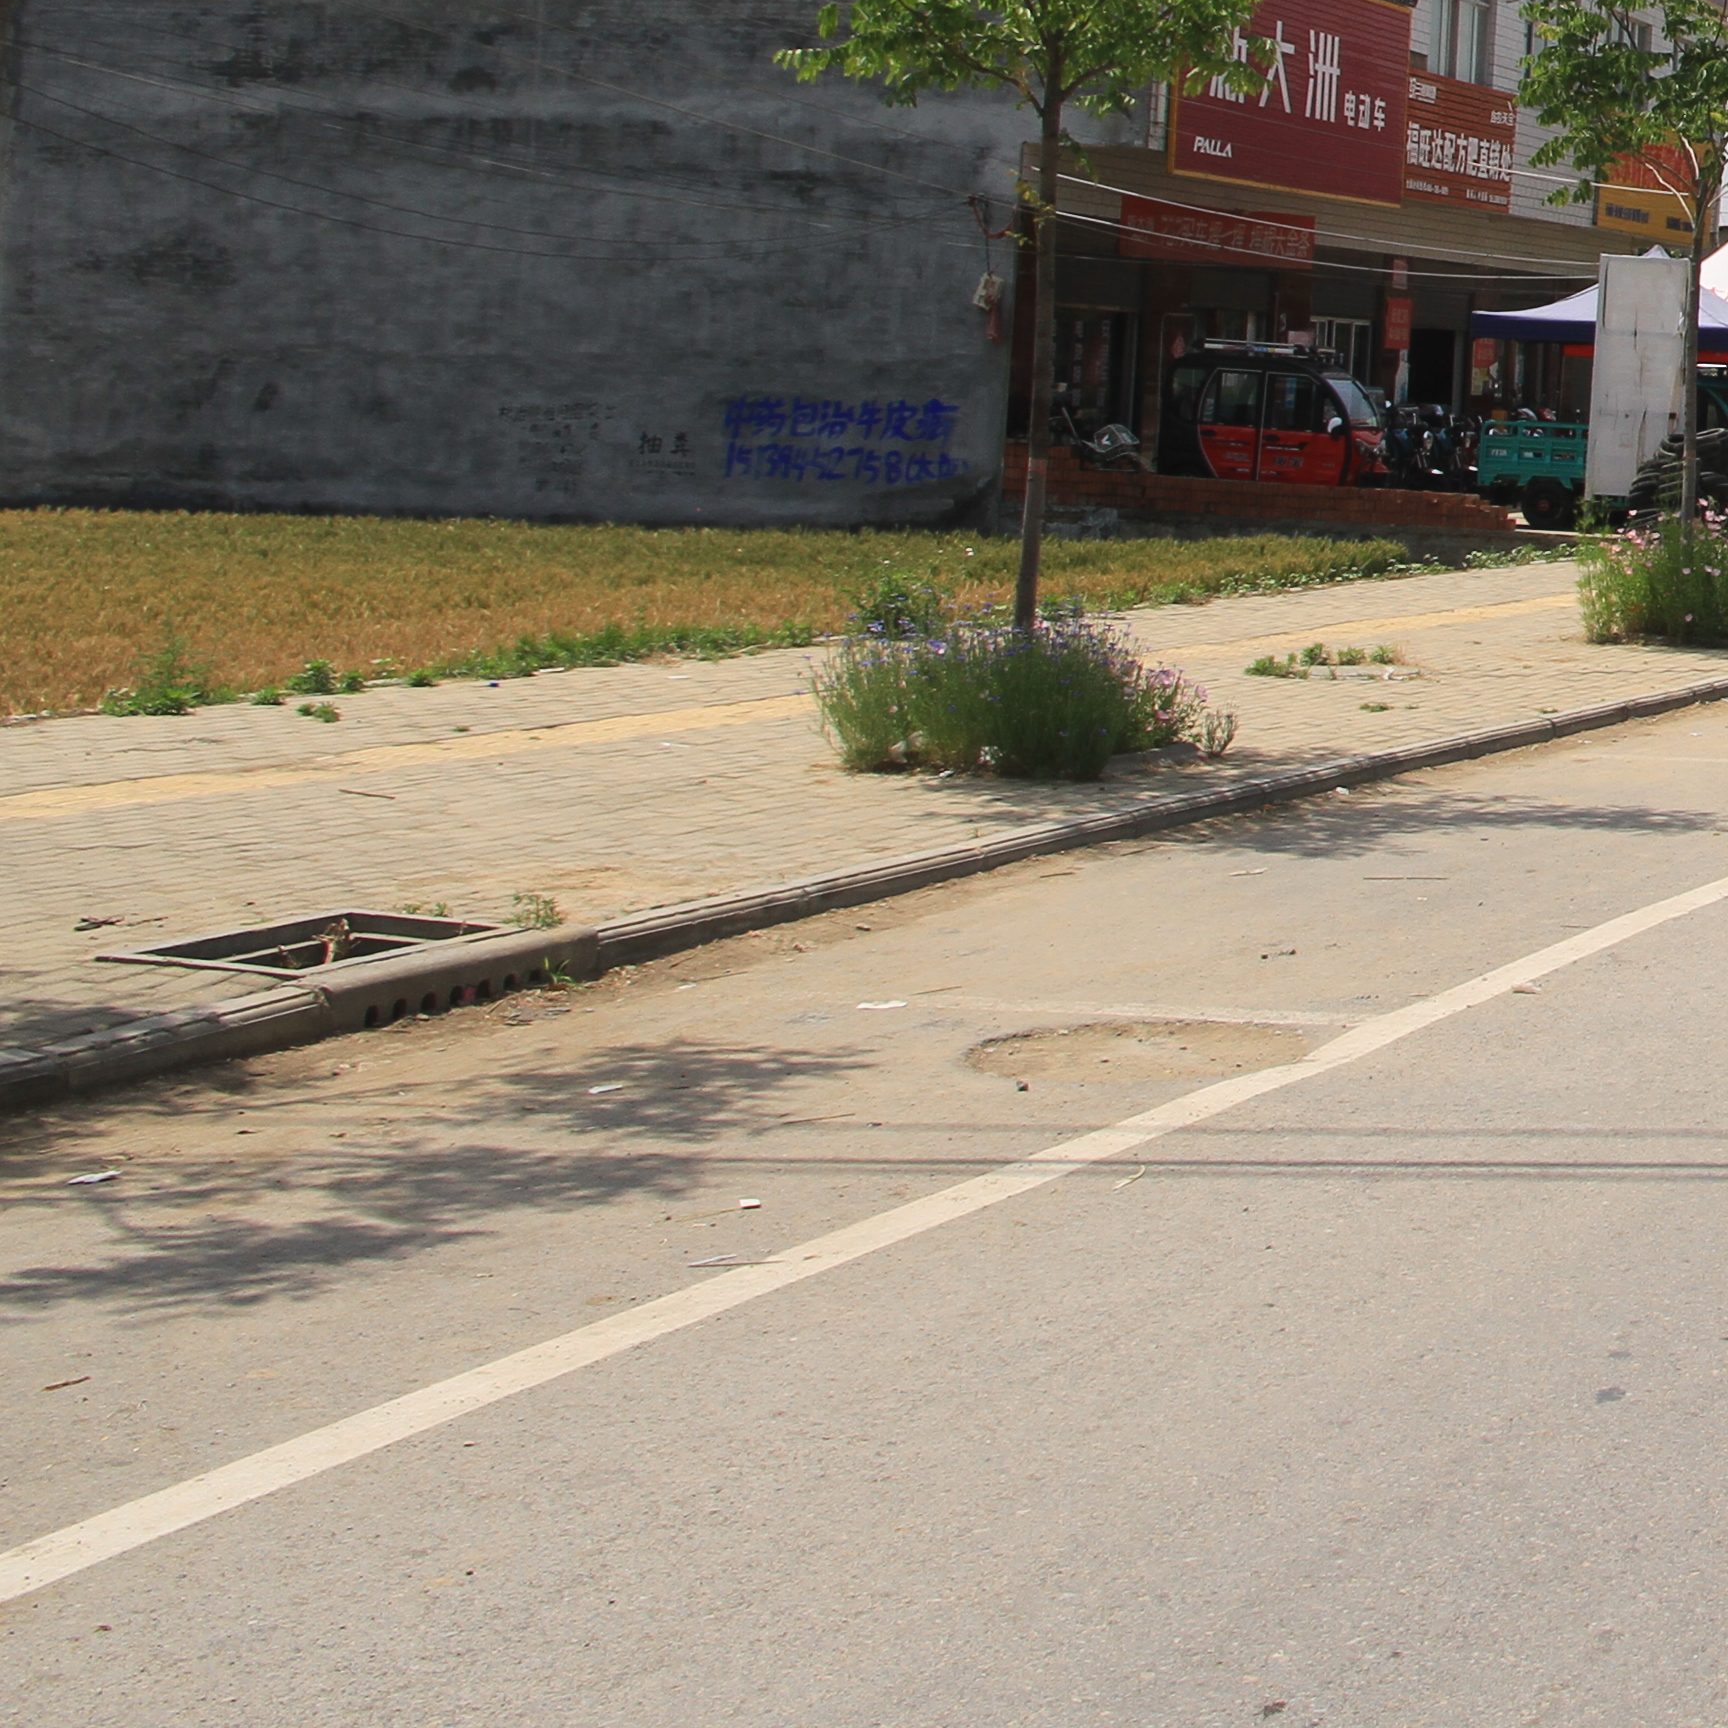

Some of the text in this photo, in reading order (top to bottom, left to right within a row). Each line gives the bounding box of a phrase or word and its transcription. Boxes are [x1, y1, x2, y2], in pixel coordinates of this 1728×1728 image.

[1343, 90, 1386, 132] 电动车
[1193, 136, 1233, 158] PALLA
